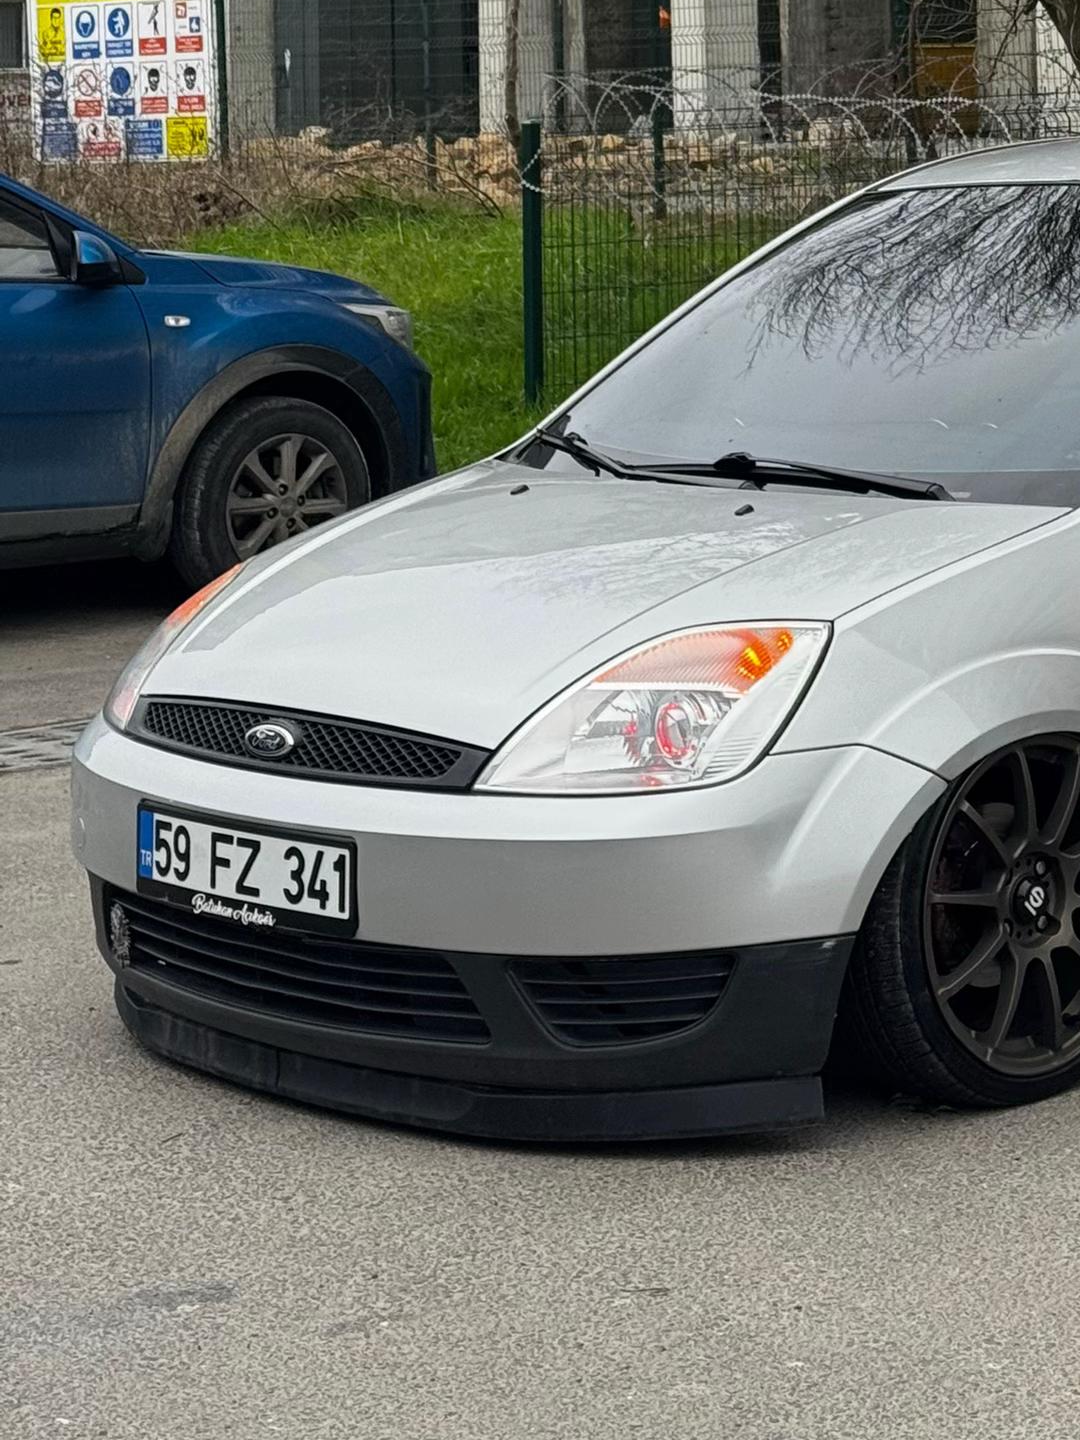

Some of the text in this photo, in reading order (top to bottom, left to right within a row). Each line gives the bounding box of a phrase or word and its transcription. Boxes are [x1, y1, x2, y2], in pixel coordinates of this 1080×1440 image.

[252, 728, 281, 751] Ford
[141, 849, 153, 868] TR
[154, 819, 348, 914] 59 FZ 341
